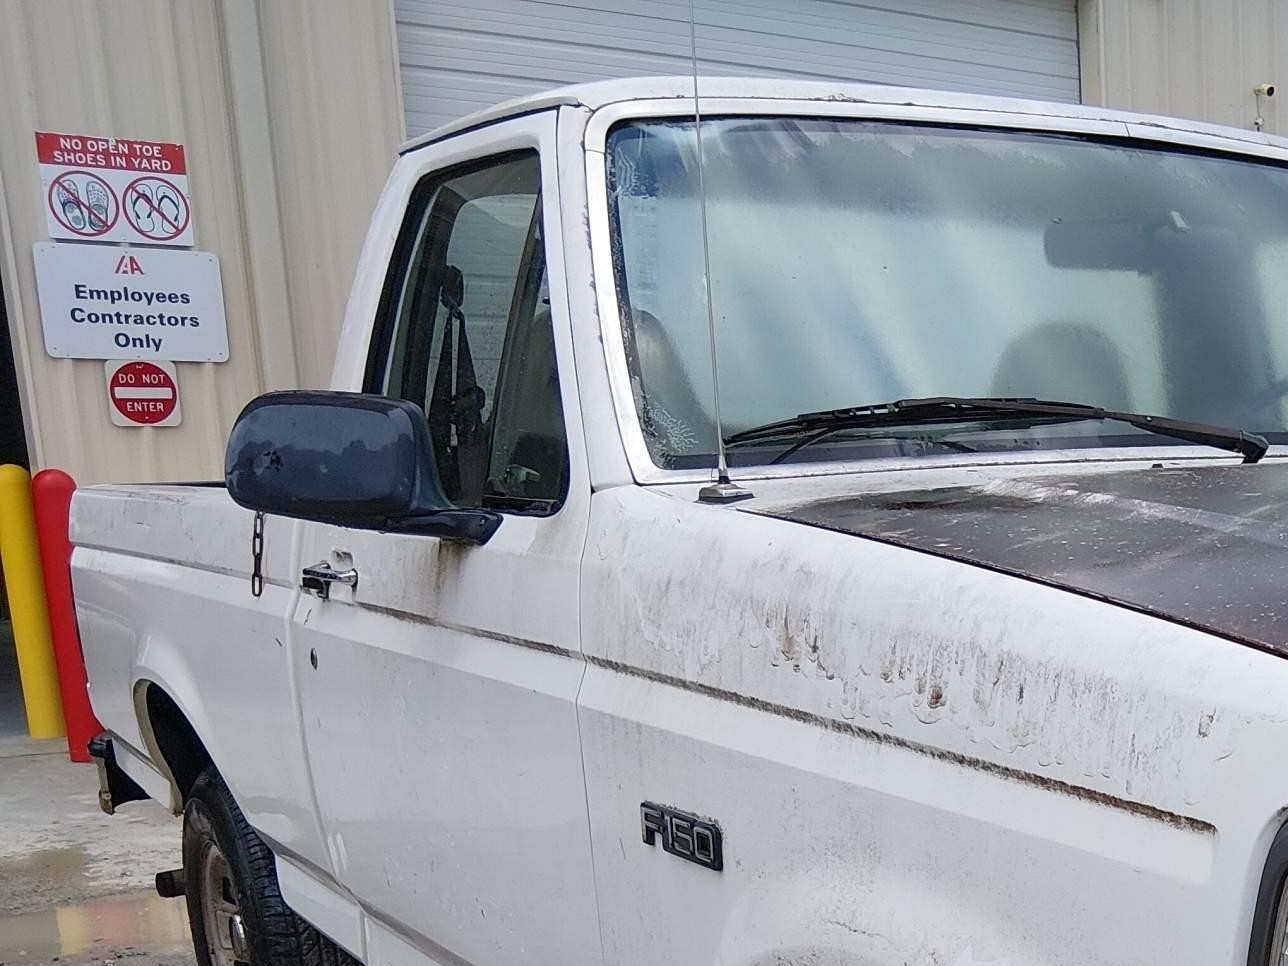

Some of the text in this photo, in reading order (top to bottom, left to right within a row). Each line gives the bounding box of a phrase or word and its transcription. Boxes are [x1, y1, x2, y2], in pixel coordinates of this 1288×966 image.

[59, 137, 162, 157] NO OPEN TOE
[53, 151, 172, 171] SHOES IN YARD
[74, 284, 191, 306] Employees
[70, 307, 200, 328] Contractors
[114, 332, 163, 352] Only
[118, 373, 166, 385] DO NOT
[126, 401, 165, 412] ENTER
